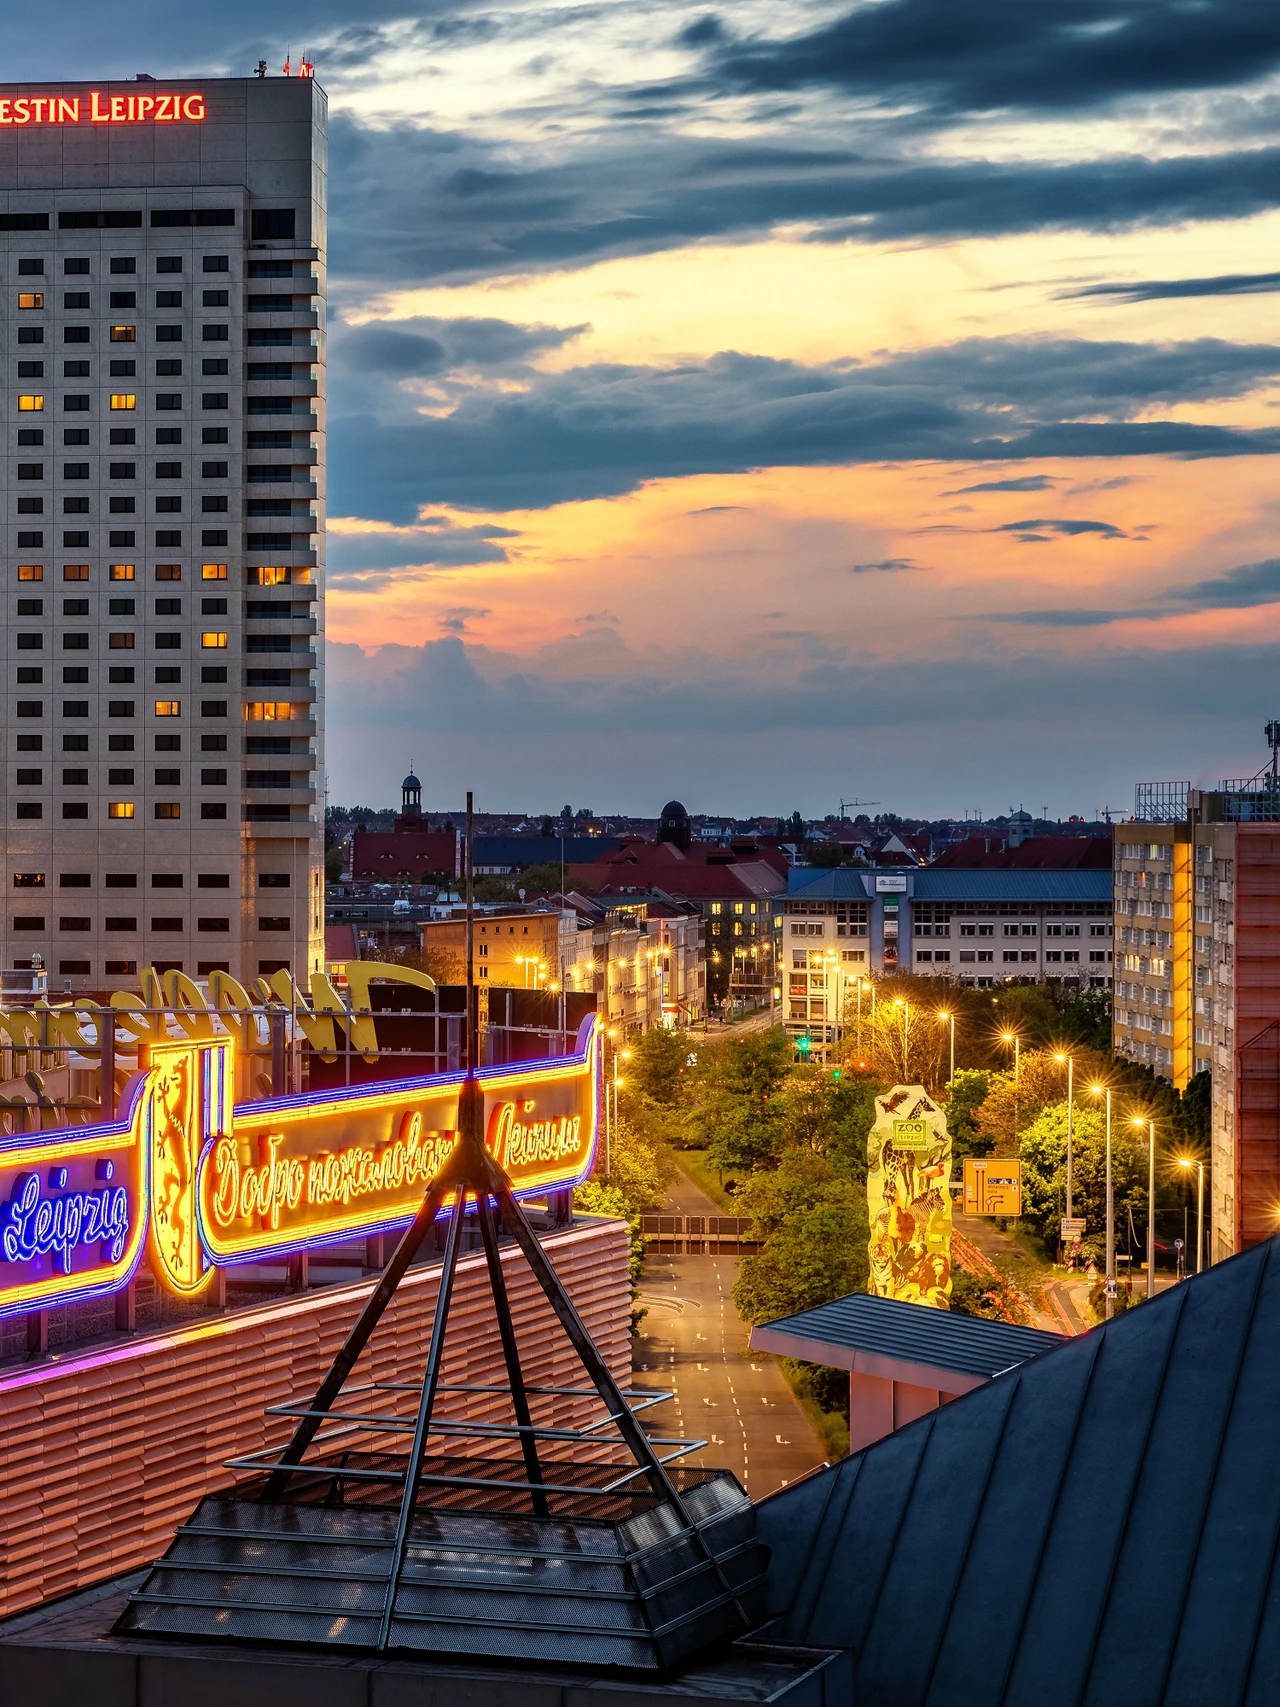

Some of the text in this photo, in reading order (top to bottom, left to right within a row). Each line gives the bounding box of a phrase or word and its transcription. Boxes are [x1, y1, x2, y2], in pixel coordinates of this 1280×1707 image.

[90, 92, 205, 122] LEIPZIG
[897, 1123, 922, 1132] ZOO
[213, 1134, 305, 1231] Добро
[2, 1159, 129, 1274] Leipzig
